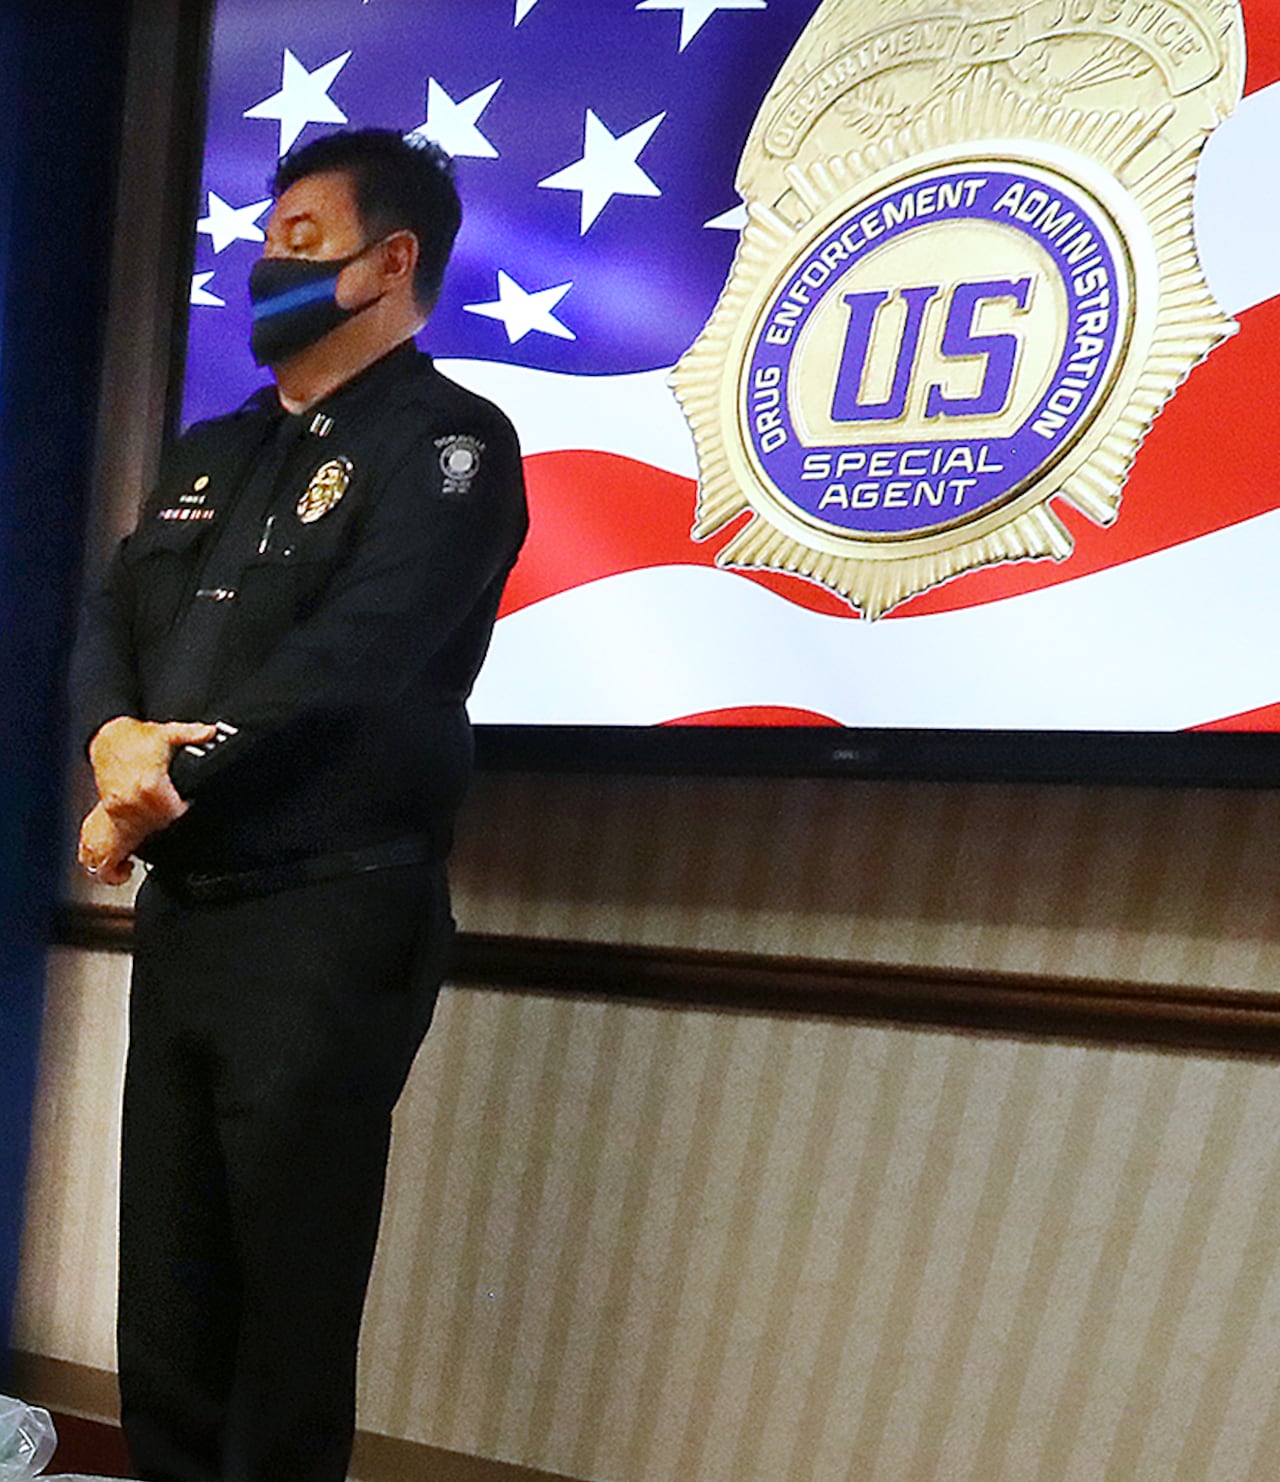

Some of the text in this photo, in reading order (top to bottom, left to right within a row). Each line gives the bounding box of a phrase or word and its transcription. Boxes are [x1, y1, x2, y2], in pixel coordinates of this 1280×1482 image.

[967, 26, 1010, 56] OF
[754, 178, 1111, 453] DRUG ENFORCEMENT ADMINISTRATION
[829, 275, 1036, 422] US
[801, 444, 1004, 483] SPECIAL
[818, 478, 977, 511] AGENT
